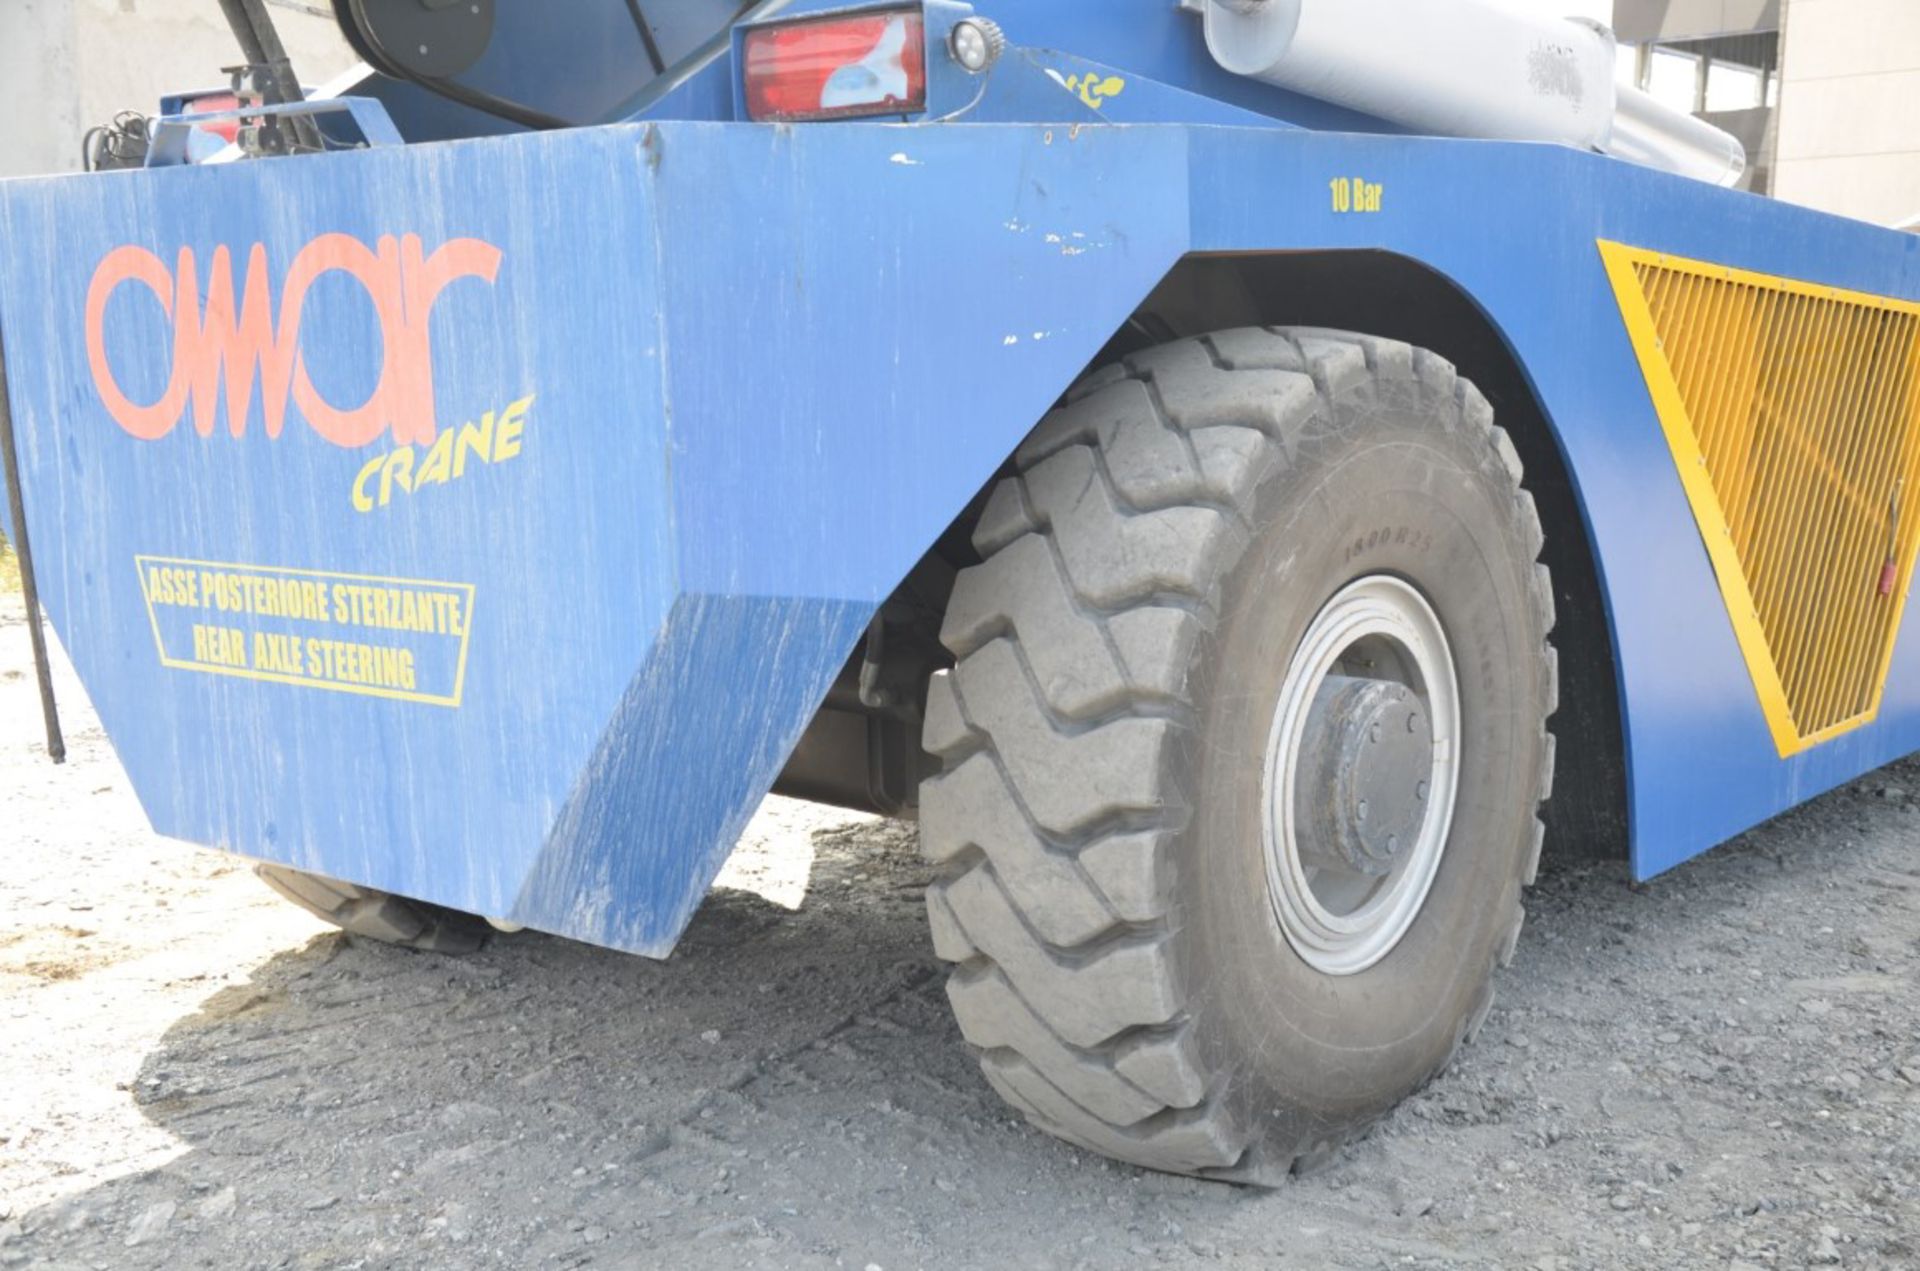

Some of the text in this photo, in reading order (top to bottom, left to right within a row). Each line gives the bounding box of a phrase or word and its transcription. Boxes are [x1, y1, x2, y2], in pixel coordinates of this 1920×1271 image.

[1329, 176, 1383, 213] 10 Bar
[351, 393, 536, 512] CRANE
[149, 567, 464, 637] ASSE POSTERIORE STERZANTE
[193, 624, 416, 690] REAR AXLE STEERING
